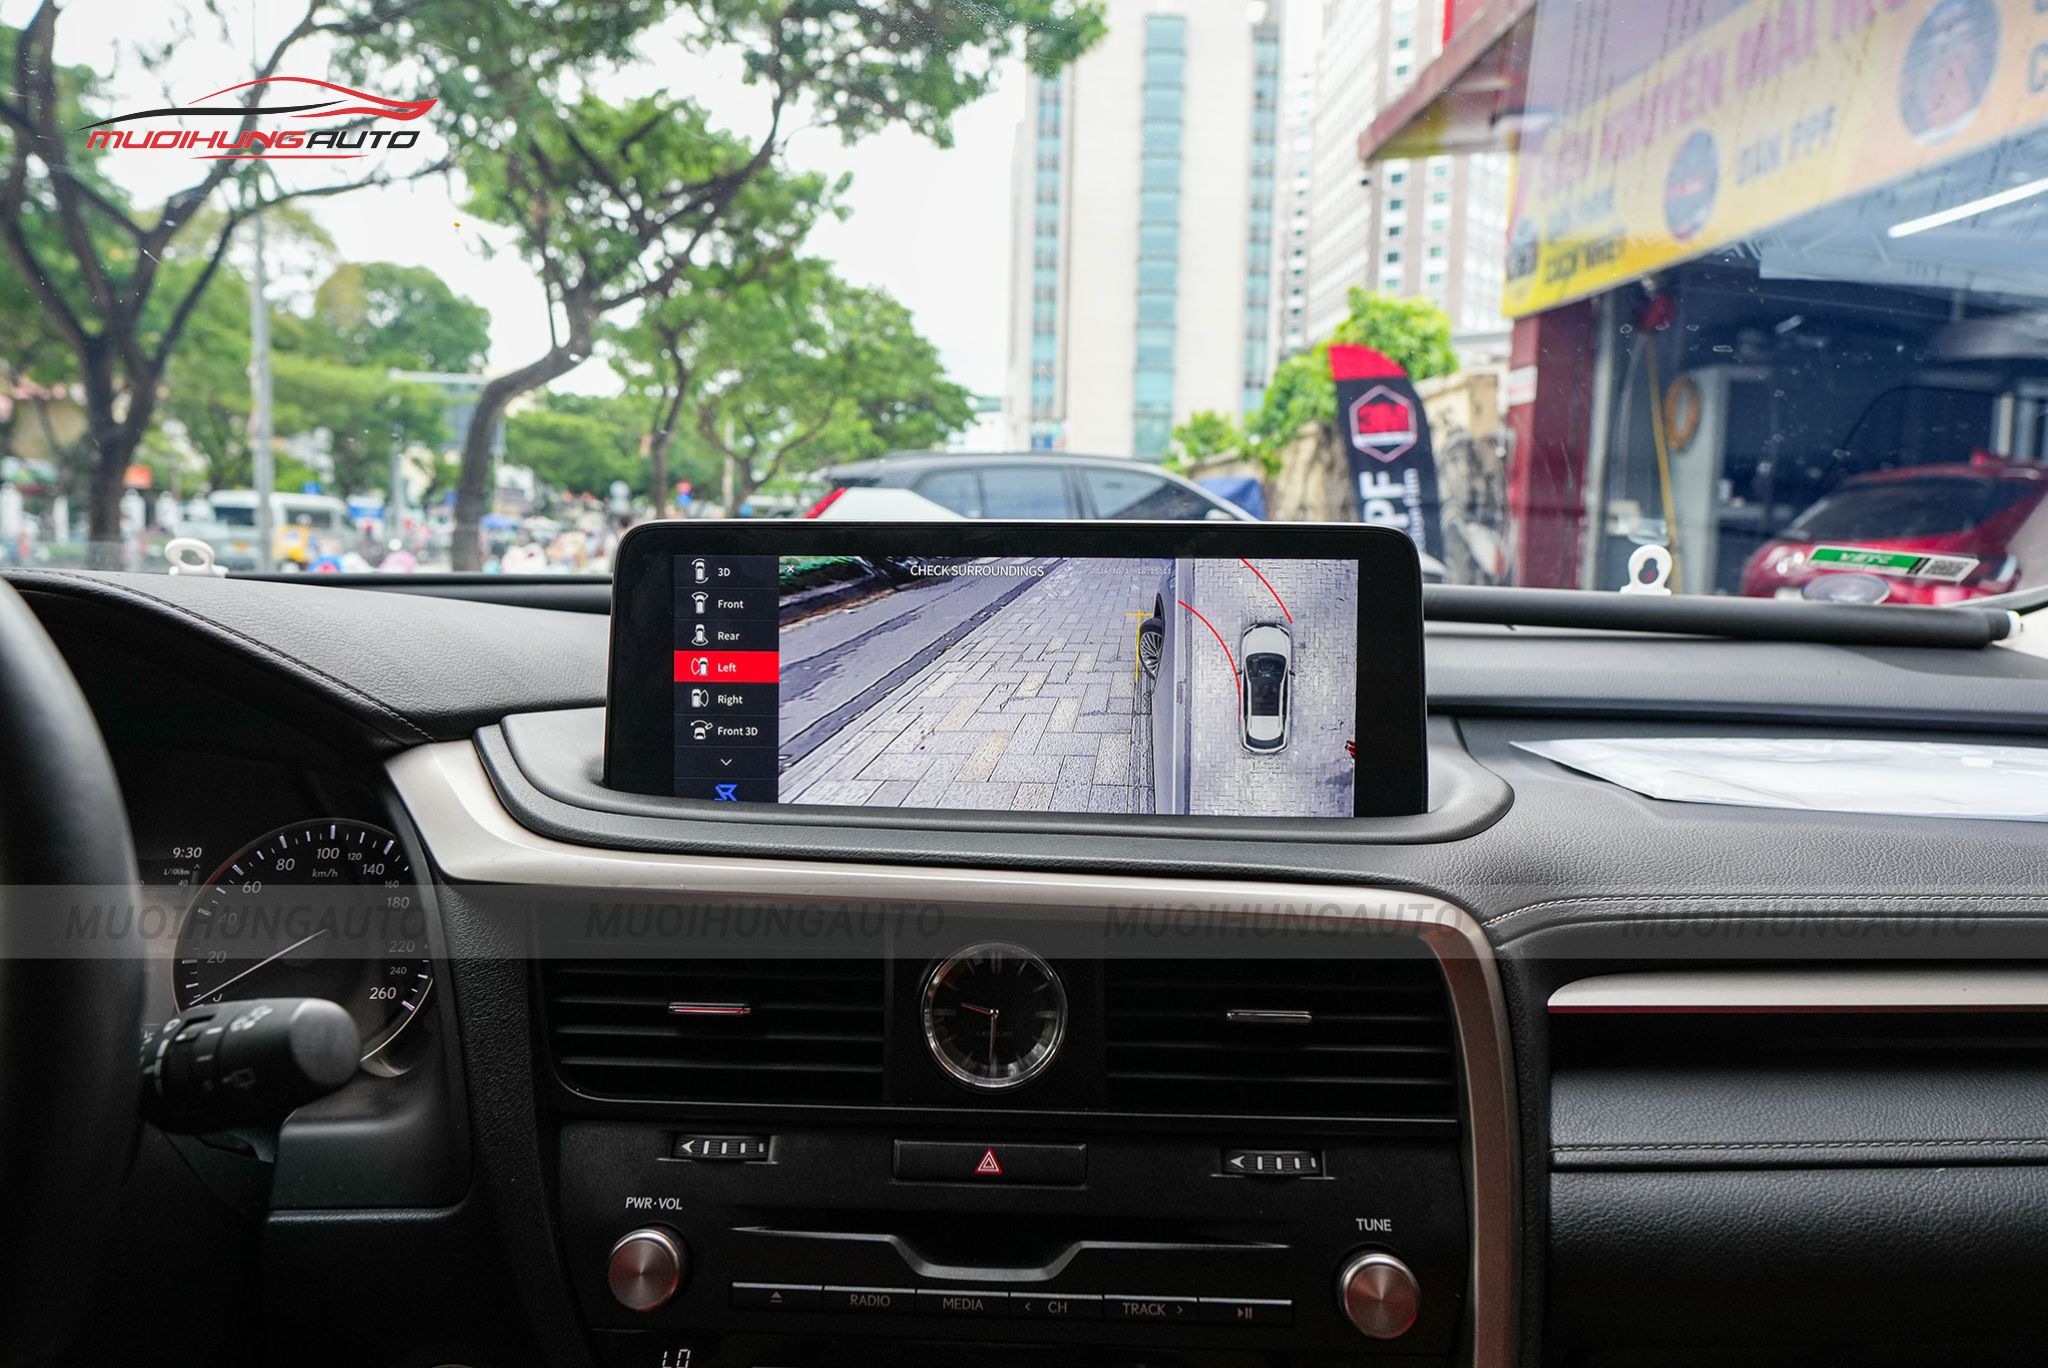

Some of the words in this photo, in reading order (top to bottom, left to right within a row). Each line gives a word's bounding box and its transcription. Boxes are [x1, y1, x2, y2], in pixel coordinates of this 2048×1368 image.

[717, 567, 731, 577] 3D
[910, 564, 949, 577] CHECK
[951, 564, 1045, 577] SURROUNDINGS
[717, 599, 744, 609] Front
[717, 631, 740, 641] Rear
[717, 663, 737, 673] Left
[717, 694, 743, 706] Right
[717, 727, 743, 737] Front
[745, 727, 758, 737] 3D
[173, 847, 202, 858] 9:30
[316, 847, 340, 860] 100
[347, 852, 362, 861] 120
[275, 858, 295, 871] 80
[362, 863, 385, 875] 140
[311, 868, 338, 878] km/h
[241, 880, 262, 894] 60
[384, 880, 399, 888] 160
[386, 896, 410, 909] 180
[389, 940, 415, 953] 220
[206, 950, 227, 964] 20
[390, 967, 407, 975] 240
[369, 987, 397, 1000] 260
[1356, 1218, 1392, 1232] TUNE
[850, 1294, 892, 1308] RADIO
[942, 1298, 984, 1311] MEDIA
[1048, 1301, 1068, 1314] CH
[1122, 1302, 1166, 1316] TRACK
